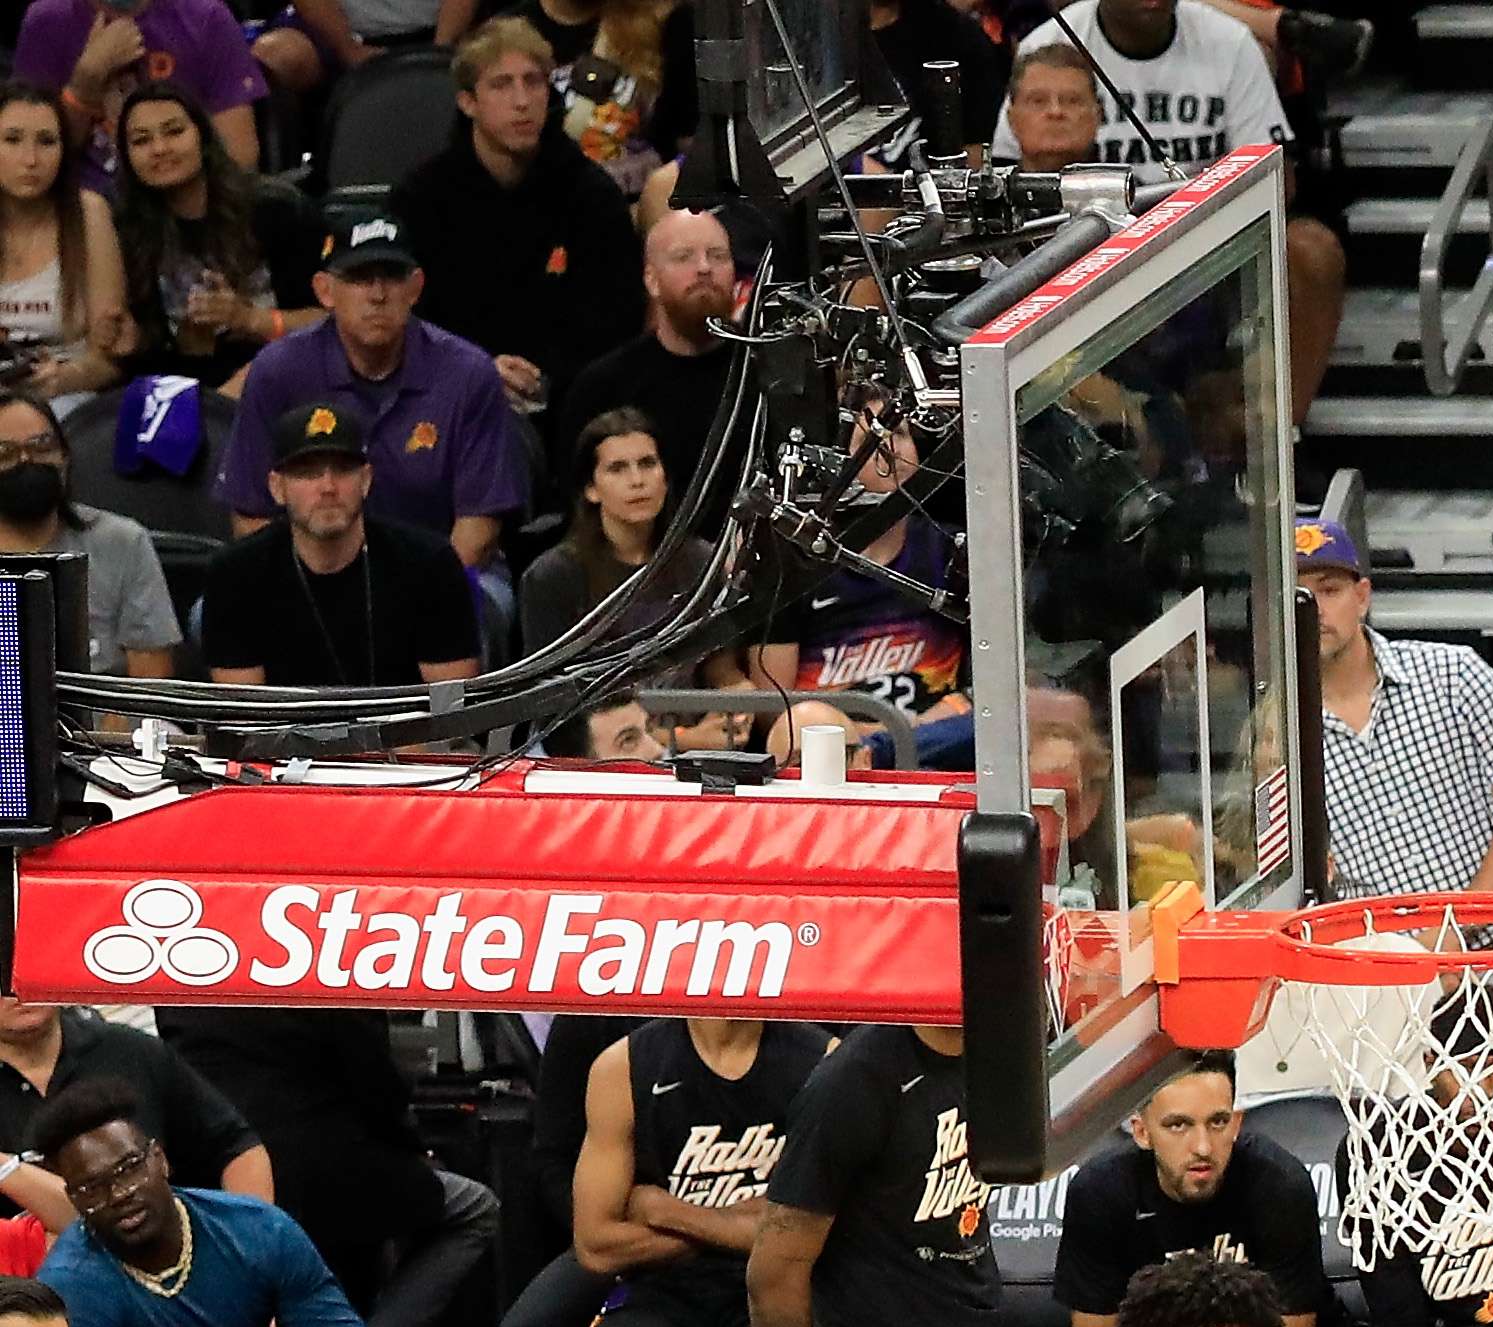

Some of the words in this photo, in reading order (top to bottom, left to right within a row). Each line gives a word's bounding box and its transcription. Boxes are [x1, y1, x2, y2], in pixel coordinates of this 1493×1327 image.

[817, 633, 926, 689] Valley
[671, 1122, 787, 1181] Rally
[989, 1223, 1042, 1242] Google
